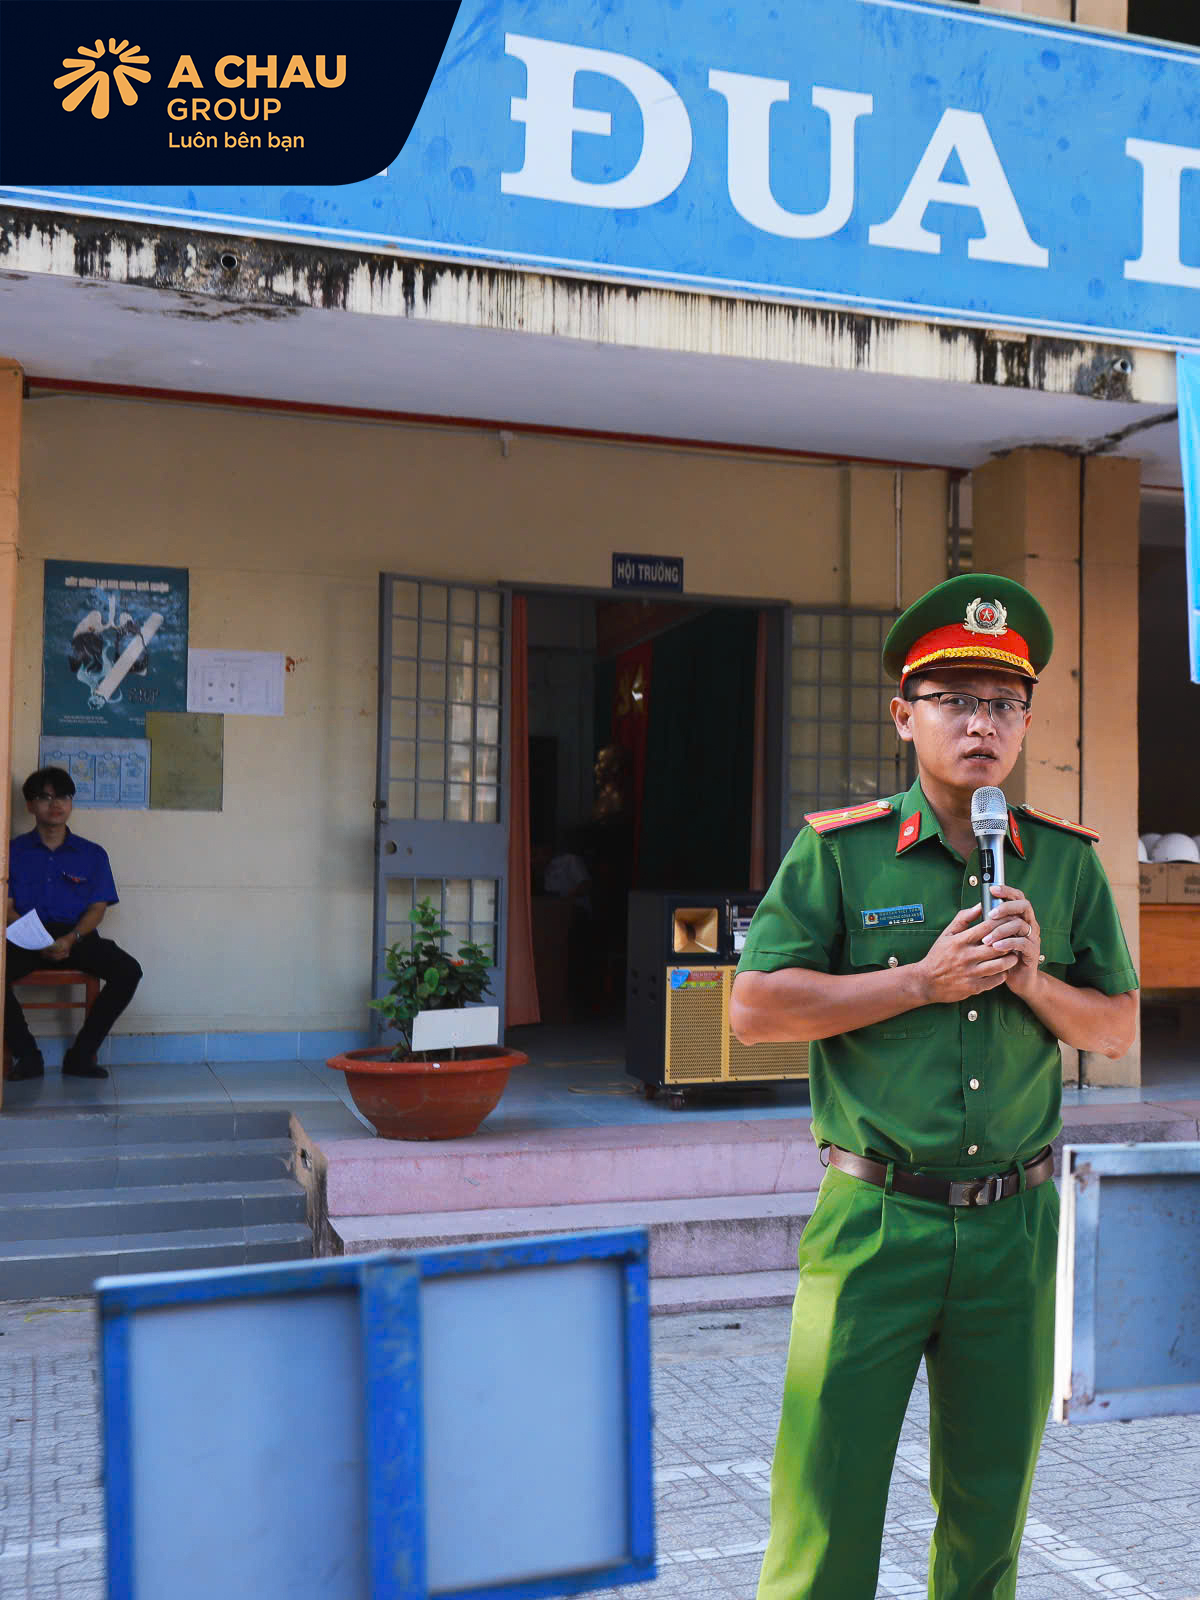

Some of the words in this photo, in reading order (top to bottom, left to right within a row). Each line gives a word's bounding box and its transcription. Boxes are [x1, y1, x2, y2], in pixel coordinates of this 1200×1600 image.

[501, 33, 1049, 268] ĐUA
[617, 560, 635, 584] HỘI
[638, 561, 679, 583] TRƯỜNG
